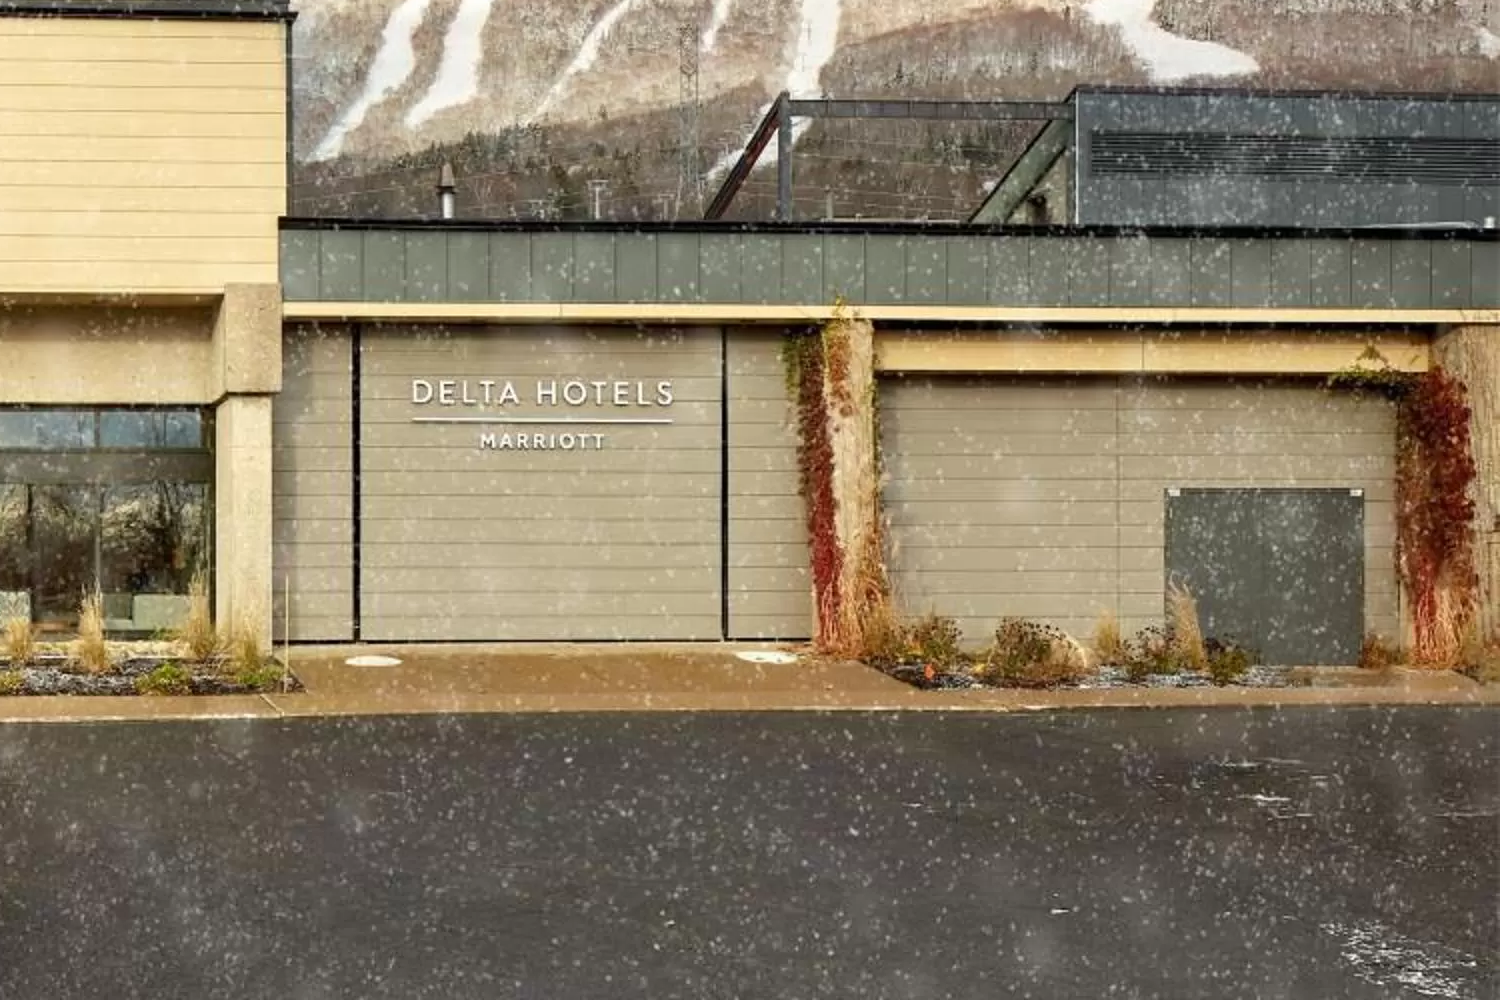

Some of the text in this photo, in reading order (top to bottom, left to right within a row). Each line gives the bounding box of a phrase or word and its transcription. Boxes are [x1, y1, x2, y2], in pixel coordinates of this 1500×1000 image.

[412, 379, 674, 405] DELTA HOTELS
[481, 433, 605, 449] MARRIOTT
